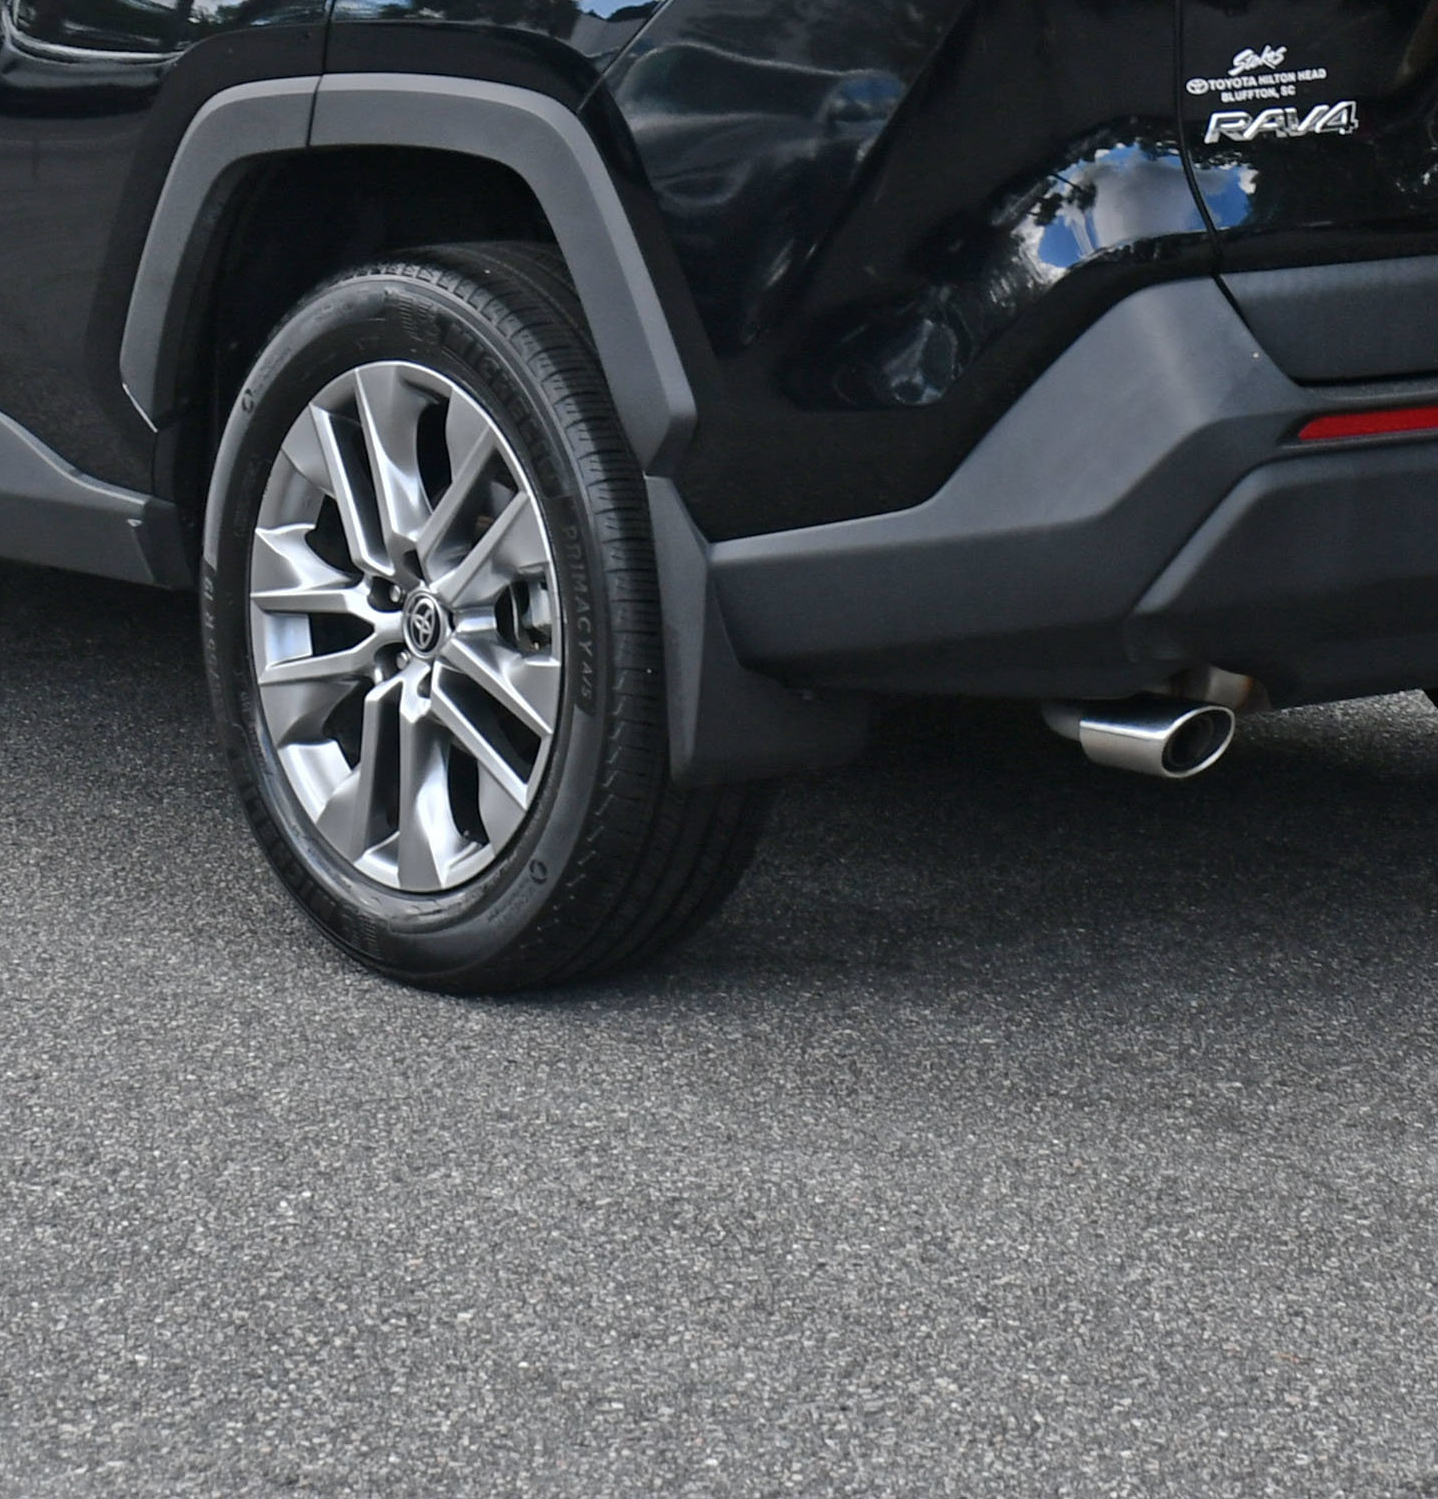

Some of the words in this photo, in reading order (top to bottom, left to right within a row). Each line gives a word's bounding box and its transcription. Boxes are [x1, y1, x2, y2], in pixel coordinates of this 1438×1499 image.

[1208, 75, 1258, 91] TOYOTA
[1258, 72, 1297, 85] HILTON
[1297, 68, 1327, 81] HEAD
[1221, 87, 1280, 103] BLUFFTON,
[1280, 85, 1296, 97] SC
[1204, 100, 1359, 144] RAV4
